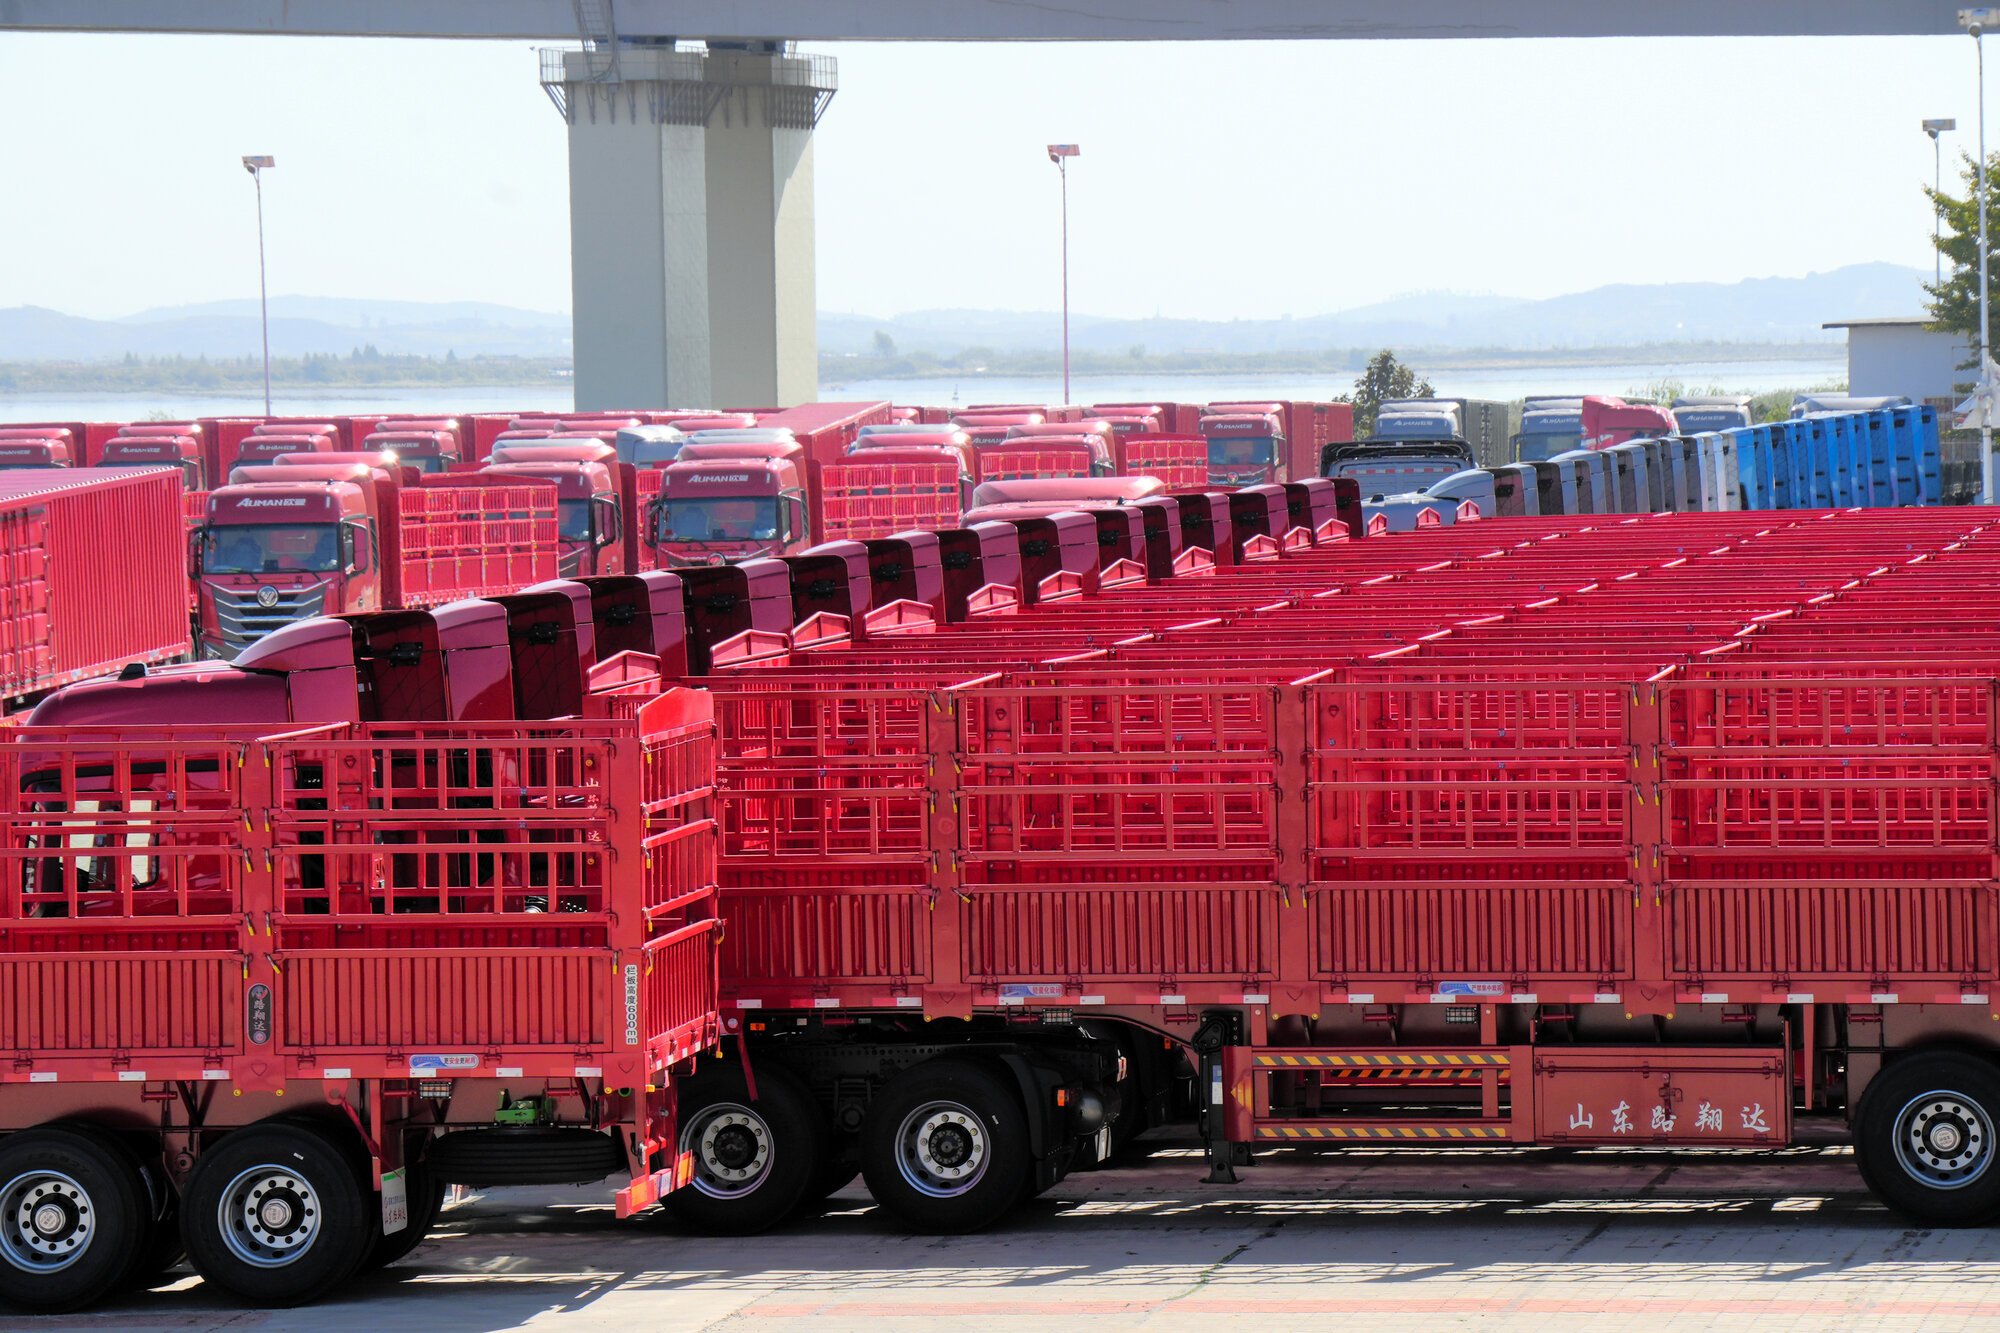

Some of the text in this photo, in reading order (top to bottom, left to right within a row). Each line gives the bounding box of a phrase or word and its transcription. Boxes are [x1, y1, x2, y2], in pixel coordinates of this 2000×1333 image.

[1569, 1100, 1771, 1134] 山东路翔达
